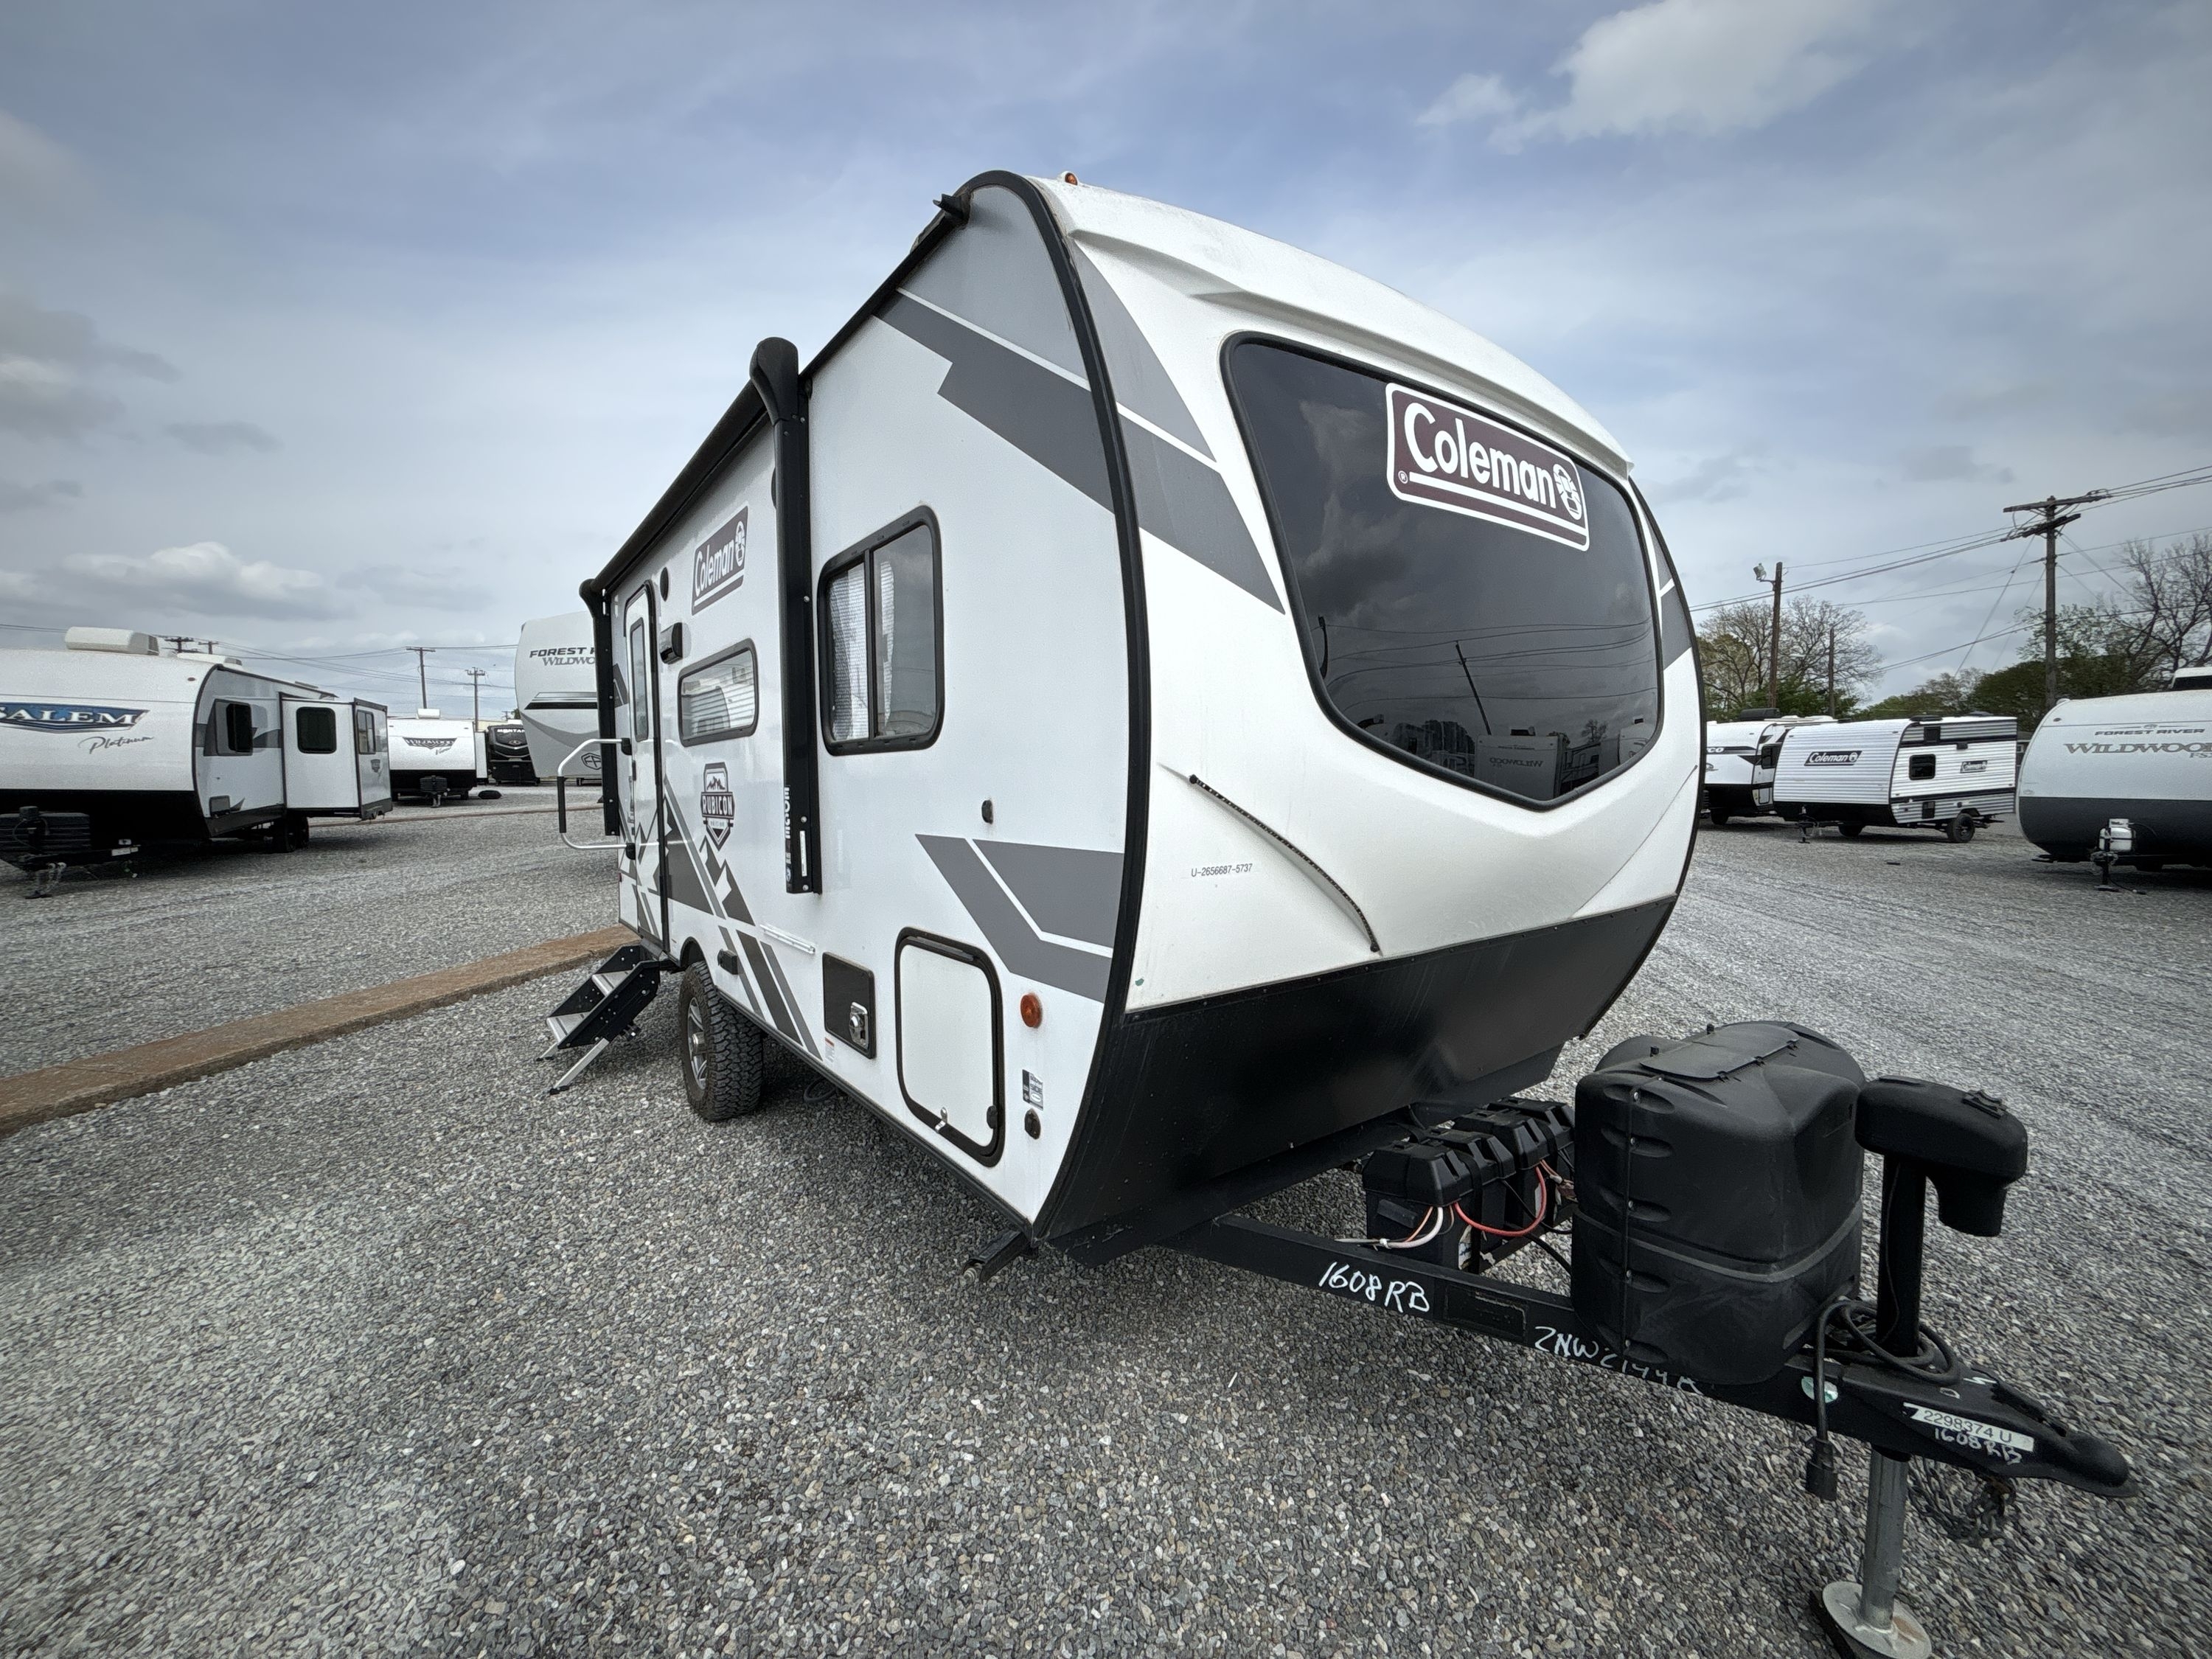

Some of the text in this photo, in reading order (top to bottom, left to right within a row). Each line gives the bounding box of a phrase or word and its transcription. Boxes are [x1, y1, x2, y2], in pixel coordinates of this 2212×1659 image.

[1404, 402, 1556, 509] Coleman
[695, 539, 734, 597] Coleman
[529, 647, 587, 658] FOREST
[1809, 752, 1849, 763] Coleman
[702, 796, 733, 815] RUBICON
[1923, 1410, 2012, 1443] 2298374 U
